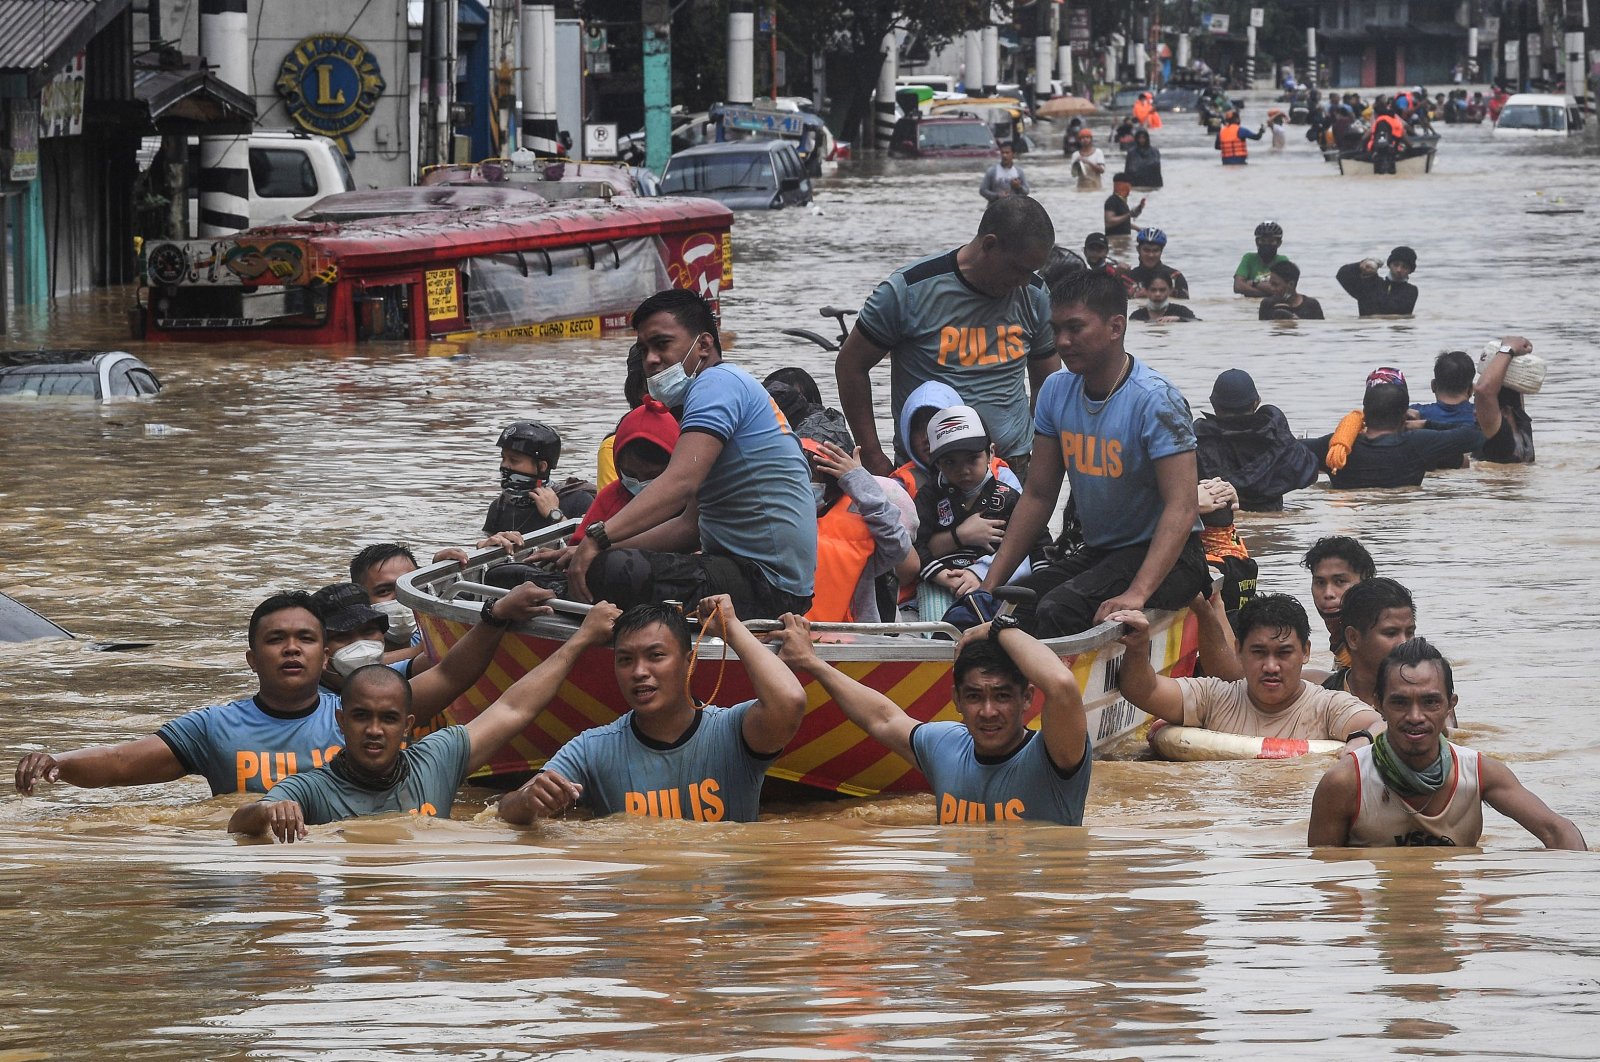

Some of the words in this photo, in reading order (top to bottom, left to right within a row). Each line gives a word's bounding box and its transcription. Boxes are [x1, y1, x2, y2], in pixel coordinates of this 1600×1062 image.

[315, 64, 346, 105] L
[938, 325, 1025, 367] PULIS
[1060, 431, 1123, 478] PULIS
